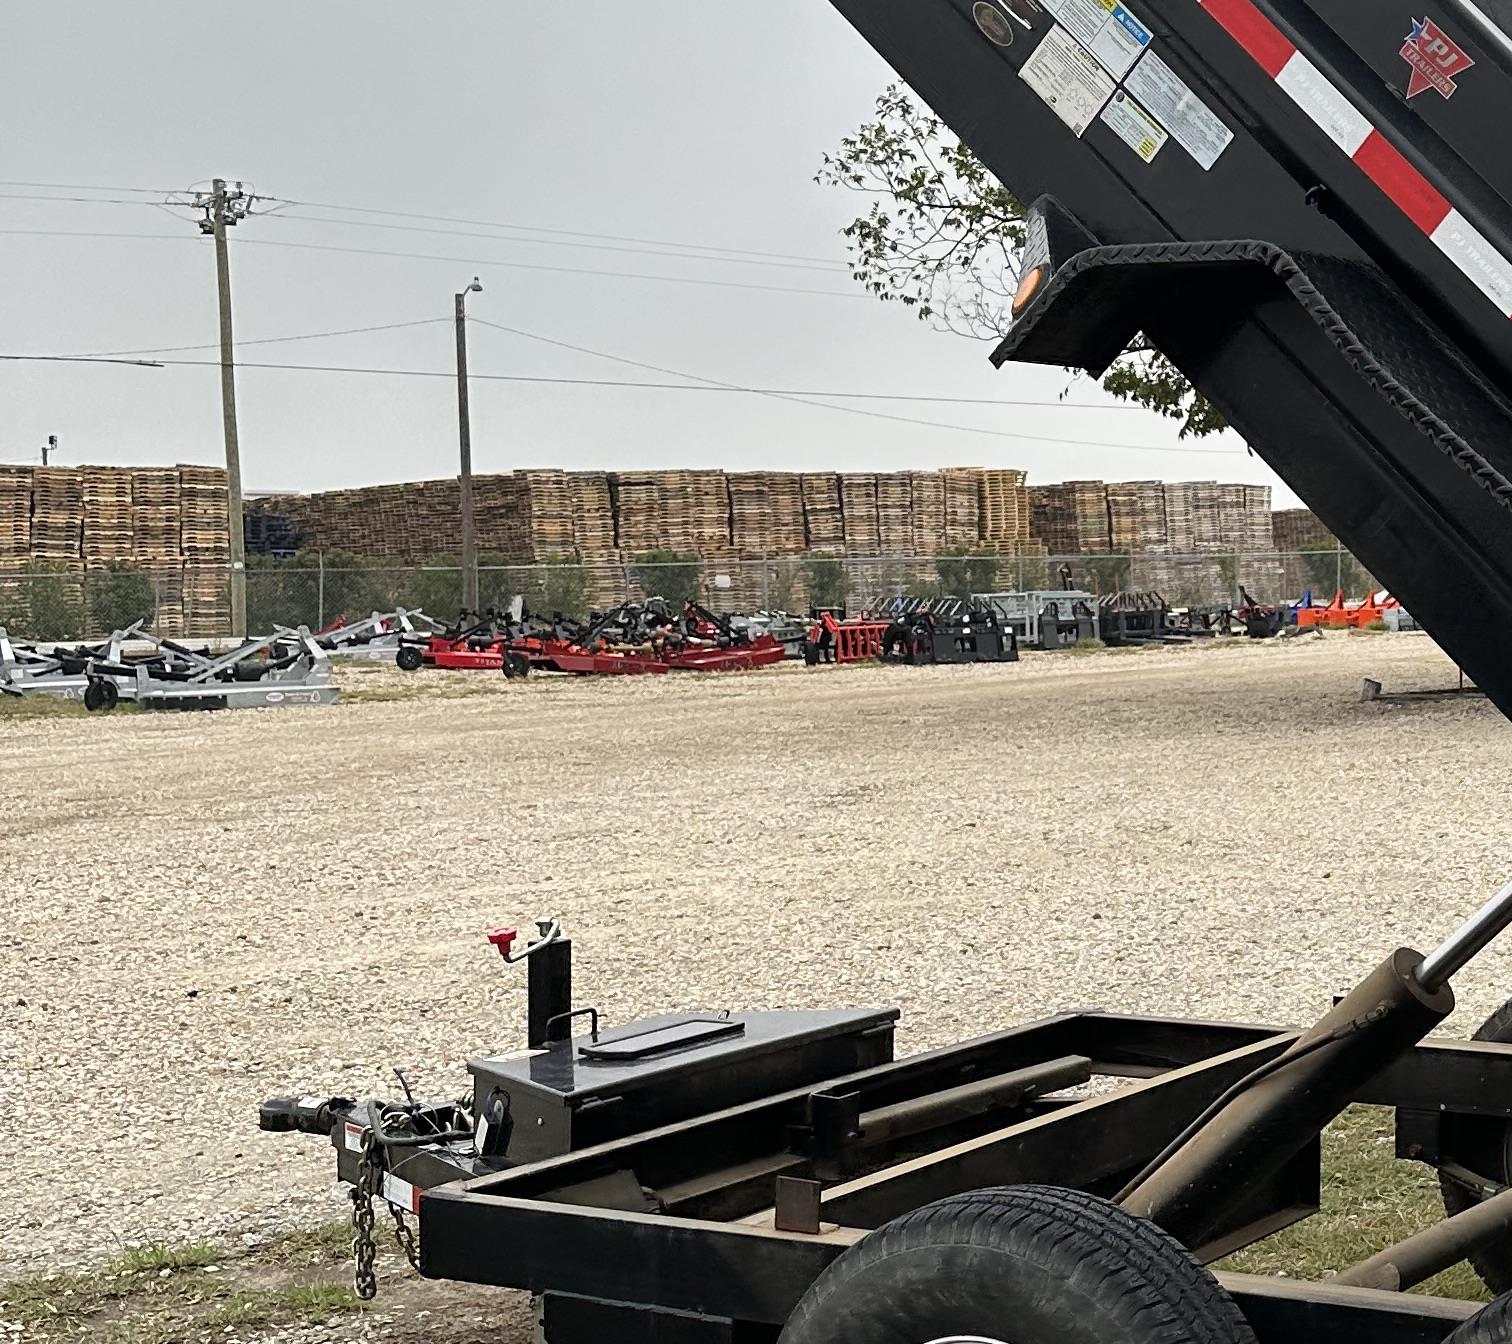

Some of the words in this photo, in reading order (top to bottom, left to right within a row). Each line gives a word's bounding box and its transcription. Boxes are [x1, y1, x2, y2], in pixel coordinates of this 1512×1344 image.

[1125, 19, 1143, 38] NOTICE
[1076, 47, 1099, 71] CAUTION
[1424, 38, 1458, 68] PJ
[1406, 48, 1452, 92] TRAILERS
